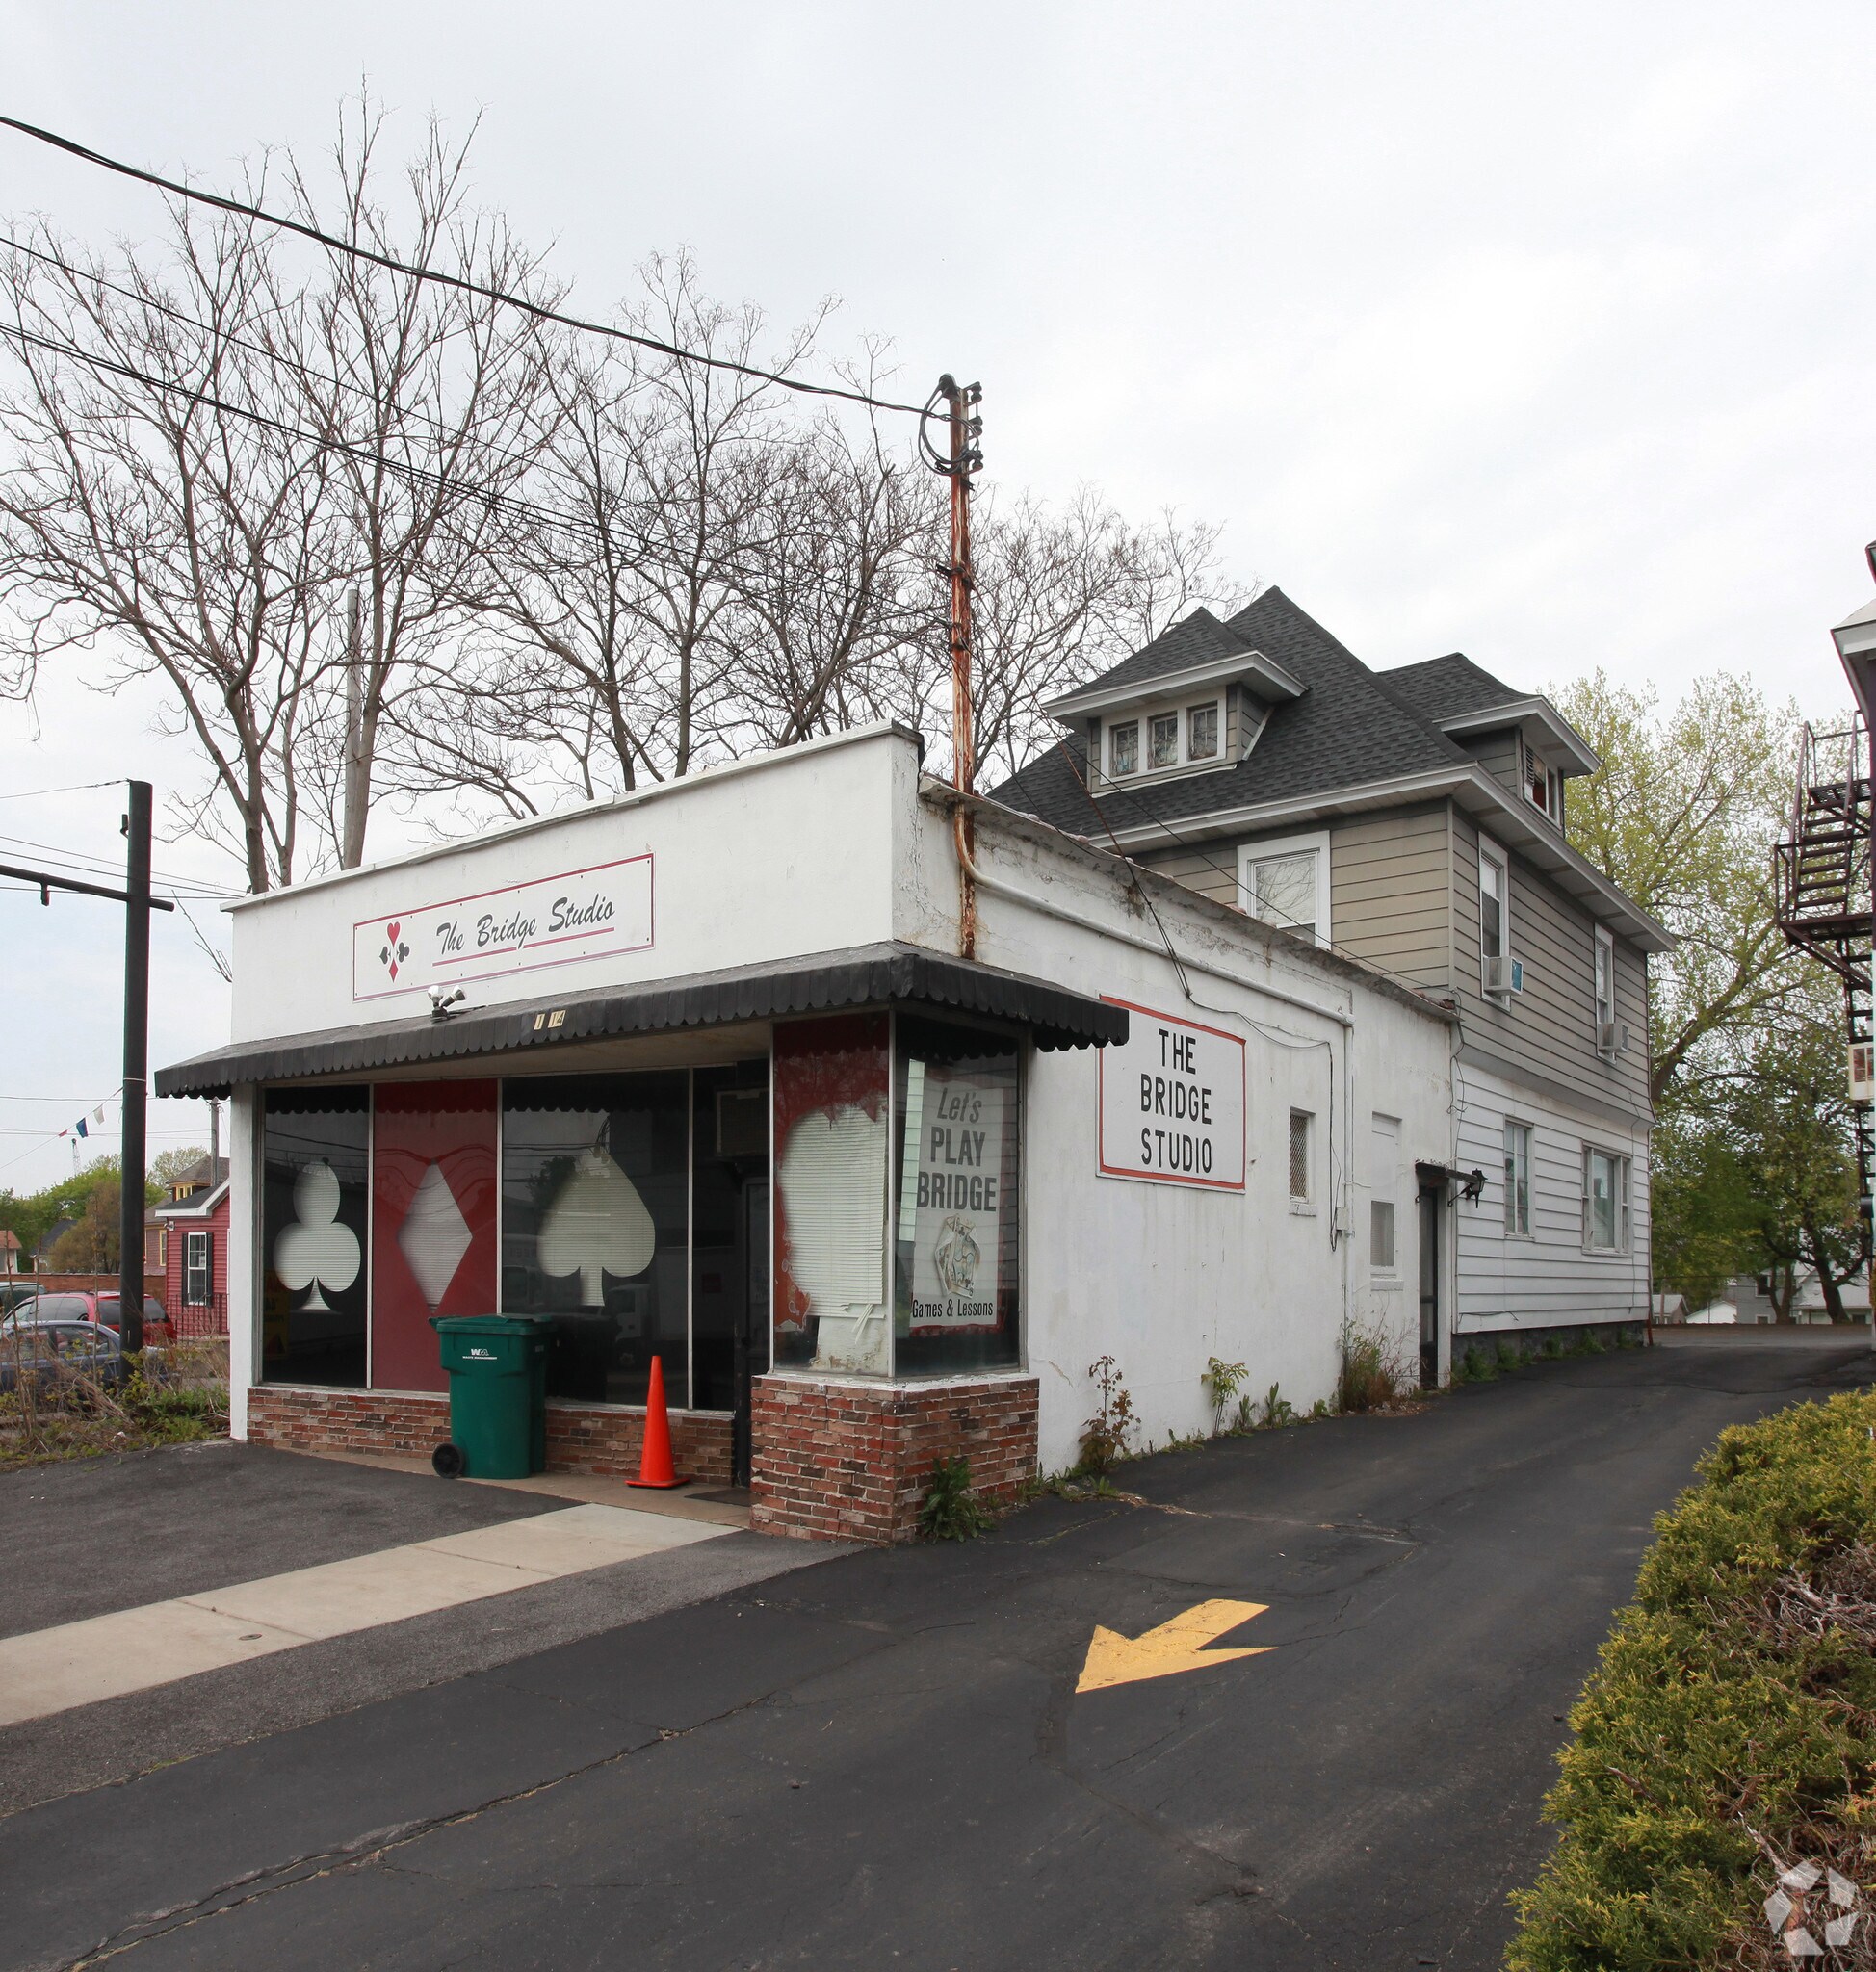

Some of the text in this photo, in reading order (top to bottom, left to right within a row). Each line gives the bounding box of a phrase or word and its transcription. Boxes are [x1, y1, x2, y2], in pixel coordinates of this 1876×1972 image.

[436, 893, 615, 955] The Bridge Studio
[1158, 1027, 1196, 1075] THE
[937, 1087, 982, 1124] Let's
[1140, 1073, 1212, 1125] BRIDGE
[930, 1126, 986, 1167] PLAY
[1140, 1127, 1212, 1174] STUDIO
[916, 1170, 997, 1212] BRIDGE
[912, 1298, 994, 1318] Games & Lessons
